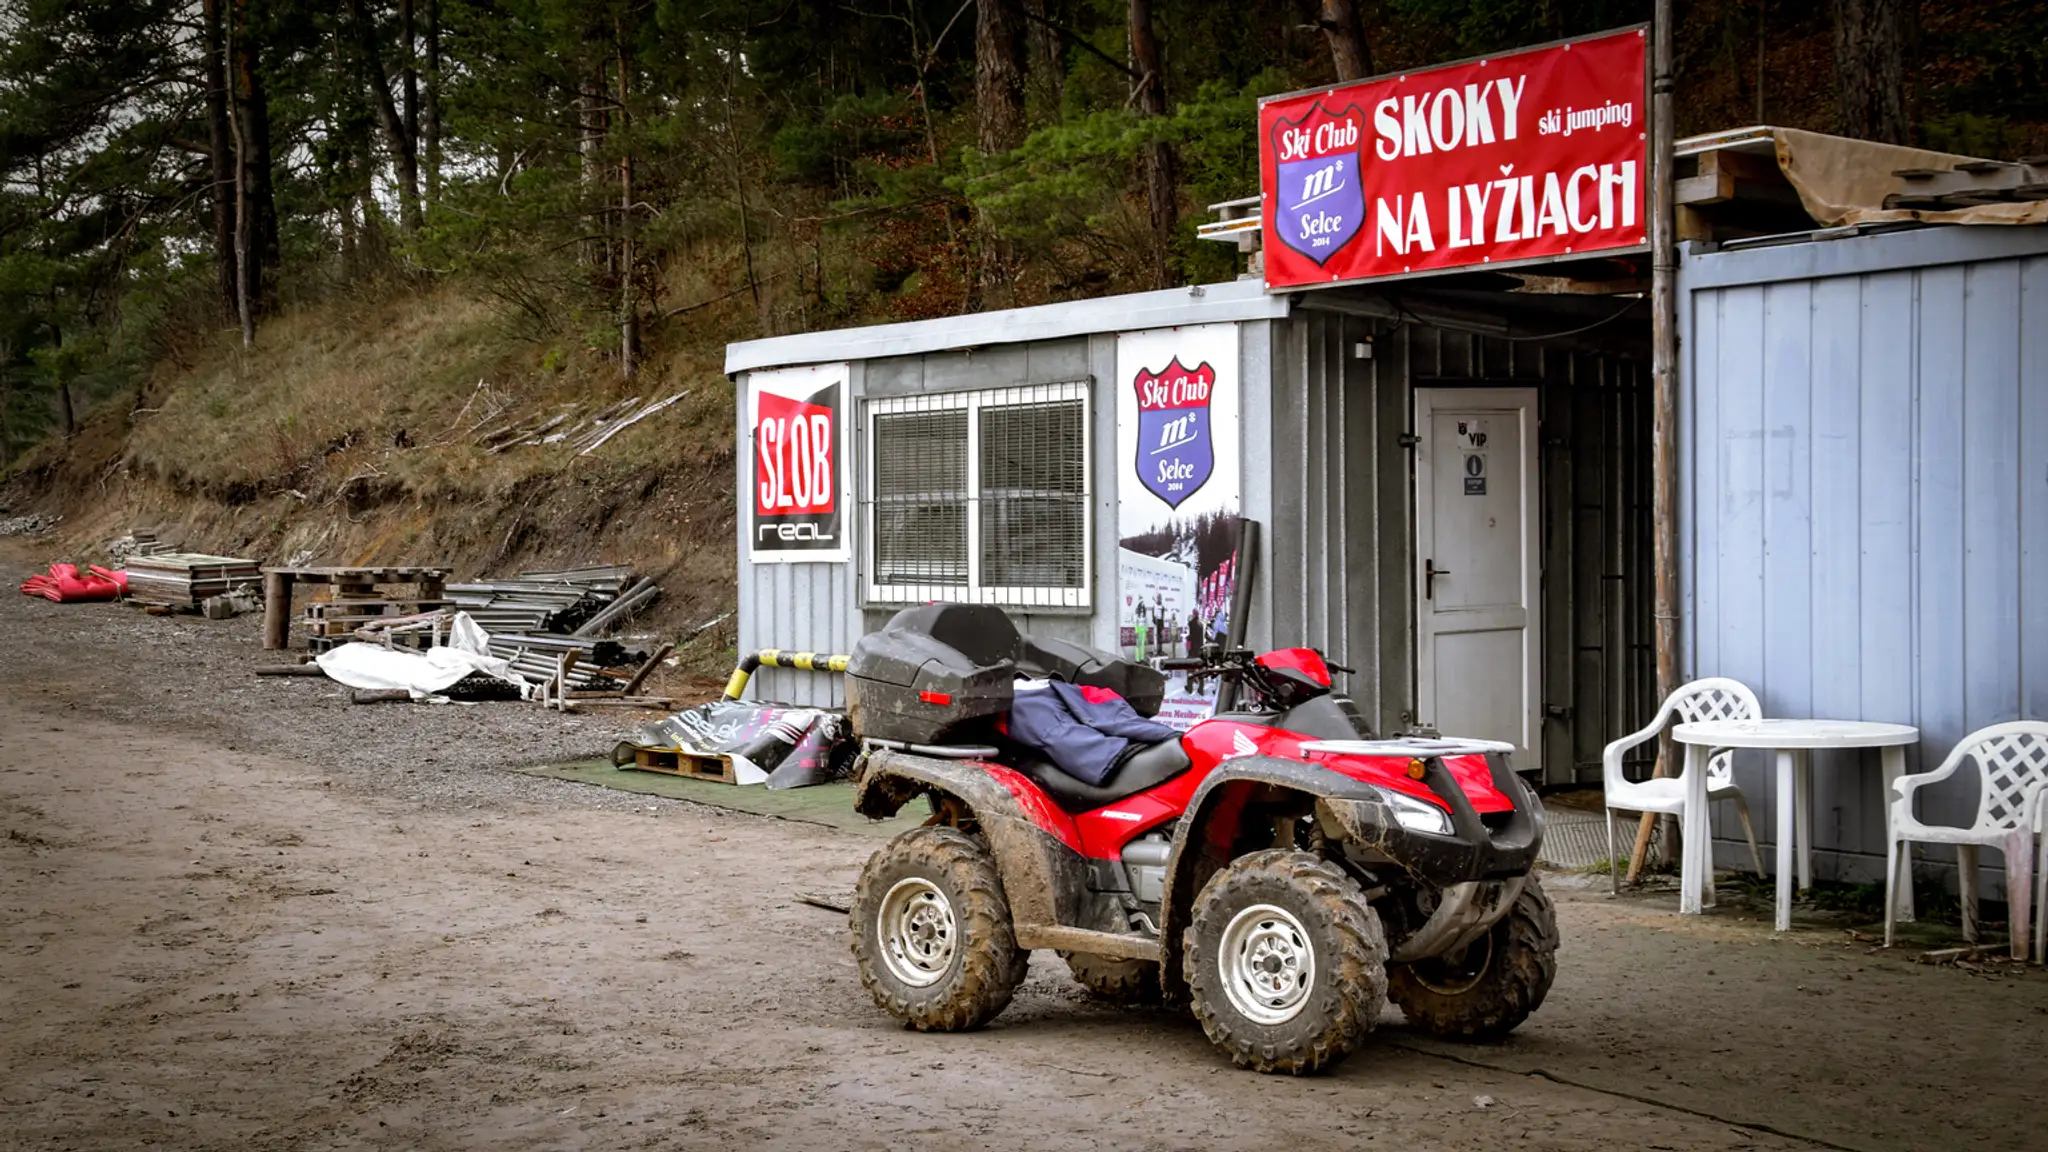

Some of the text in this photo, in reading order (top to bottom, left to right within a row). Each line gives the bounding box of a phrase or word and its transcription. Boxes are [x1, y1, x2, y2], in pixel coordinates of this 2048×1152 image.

[1374, 75, 1526, 161] SKOKY
[1538, 100, 1632, 137] ski jumping
[1280, 118, 1358, 160] Ski Club
[1377, 160, 1636, 257] NA LYŽIACH
[1300, 211, 1342, 240] Selce
[1312, 236, 1330, 247] 2014
[1141, 375, 1208, 408] Ski Club
[1468, 432, 1487, 447] VIP
[761, 414, 830, 509] SLOB
[1157, 458, 1194, 483] Selce
[1167, 482, 1183, 491] 2014
